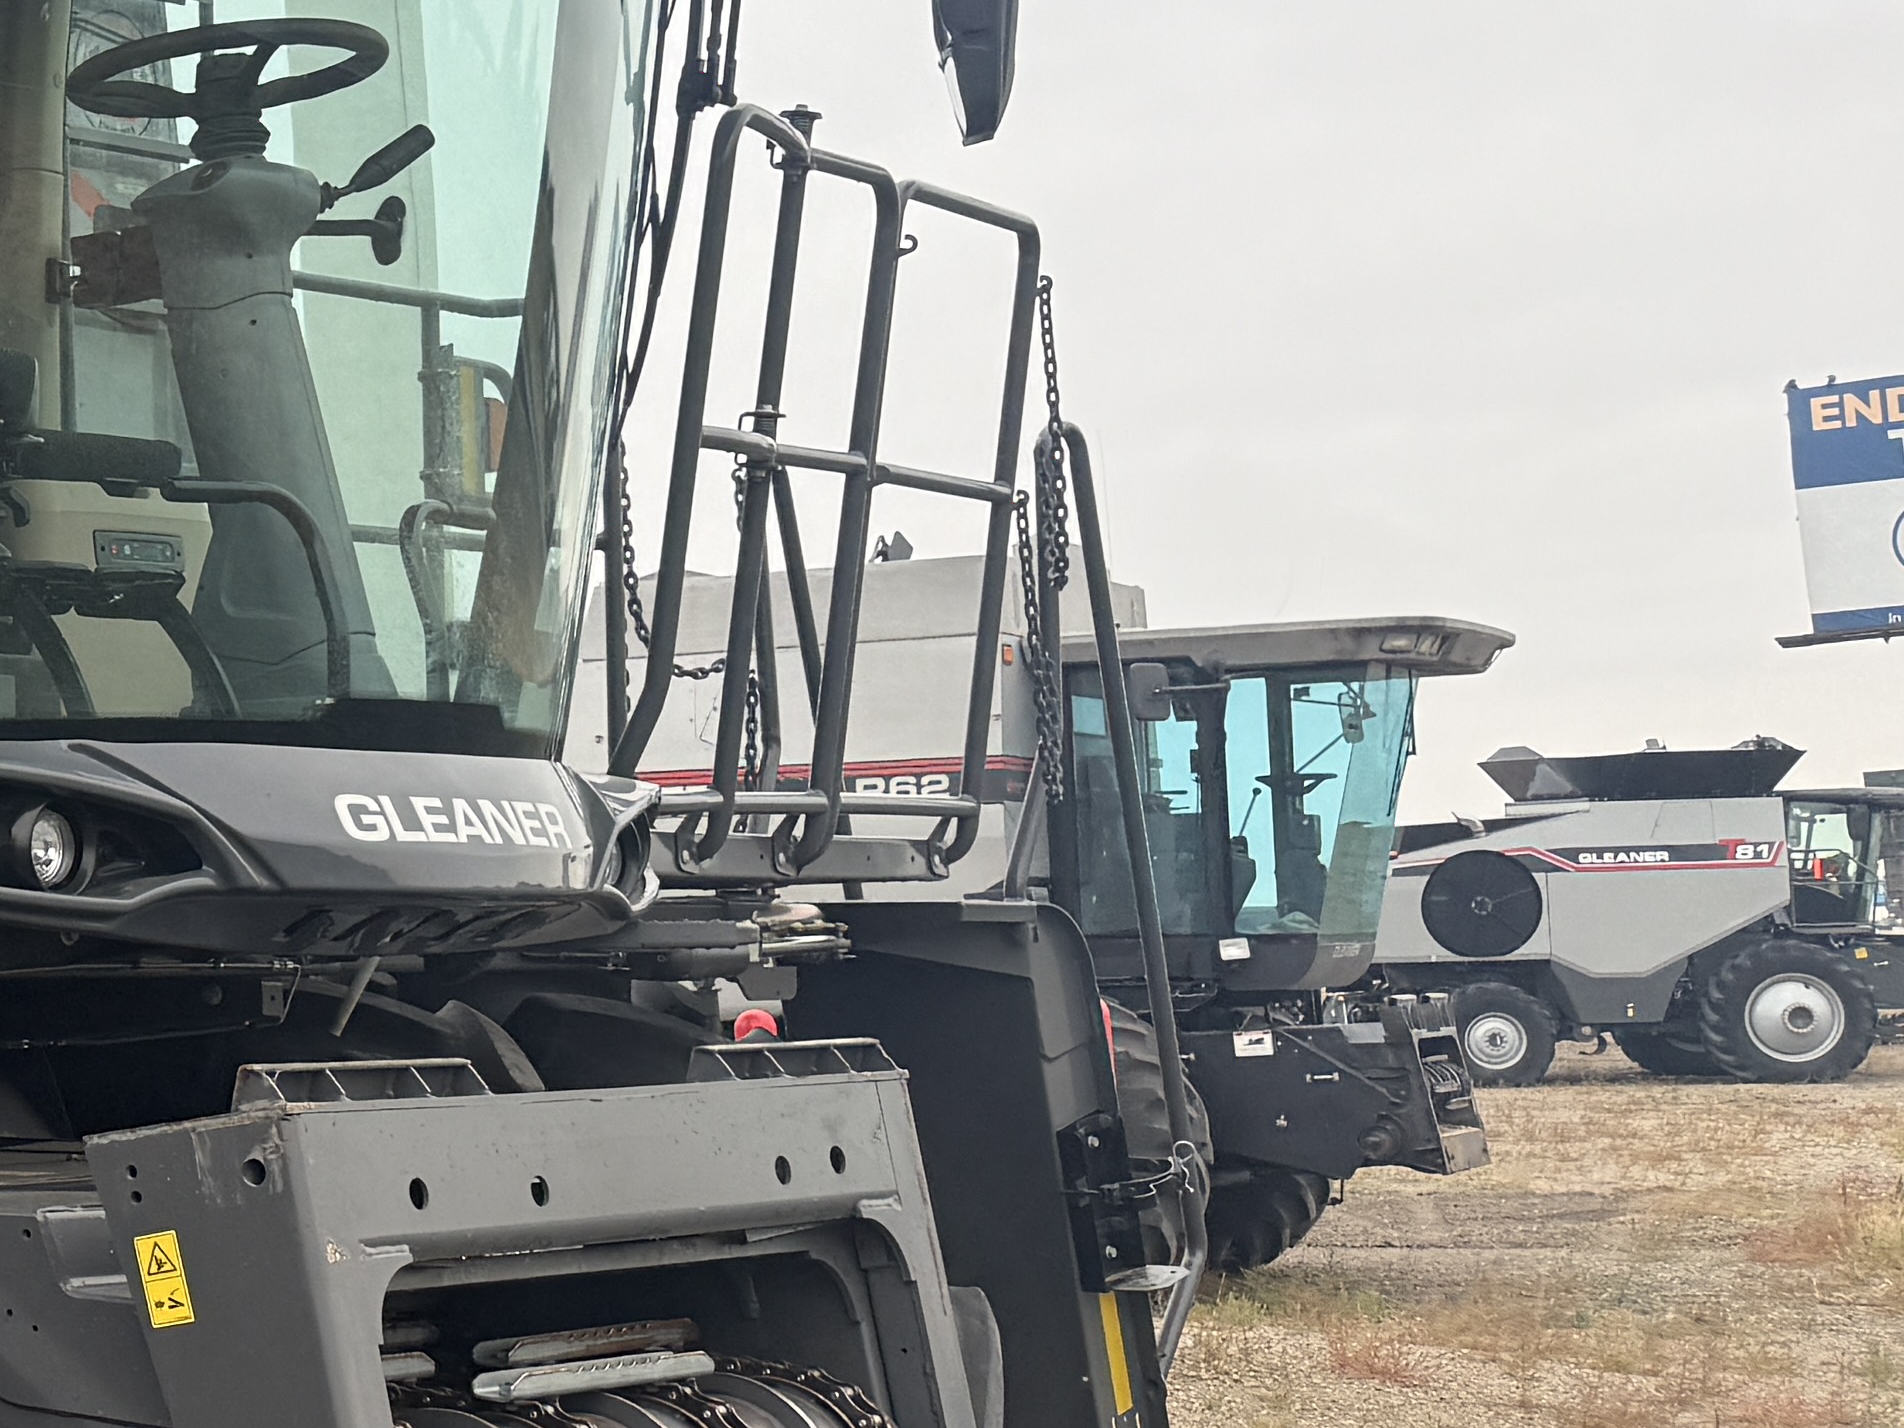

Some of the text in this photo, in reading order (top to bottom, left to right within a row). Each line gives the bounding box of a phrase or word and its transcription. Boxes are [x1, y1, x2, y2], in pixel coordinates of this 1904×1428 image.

[334, 792, 573, 849] GLEANER
[1578, 838, 1770, 864] GLEANER T81
